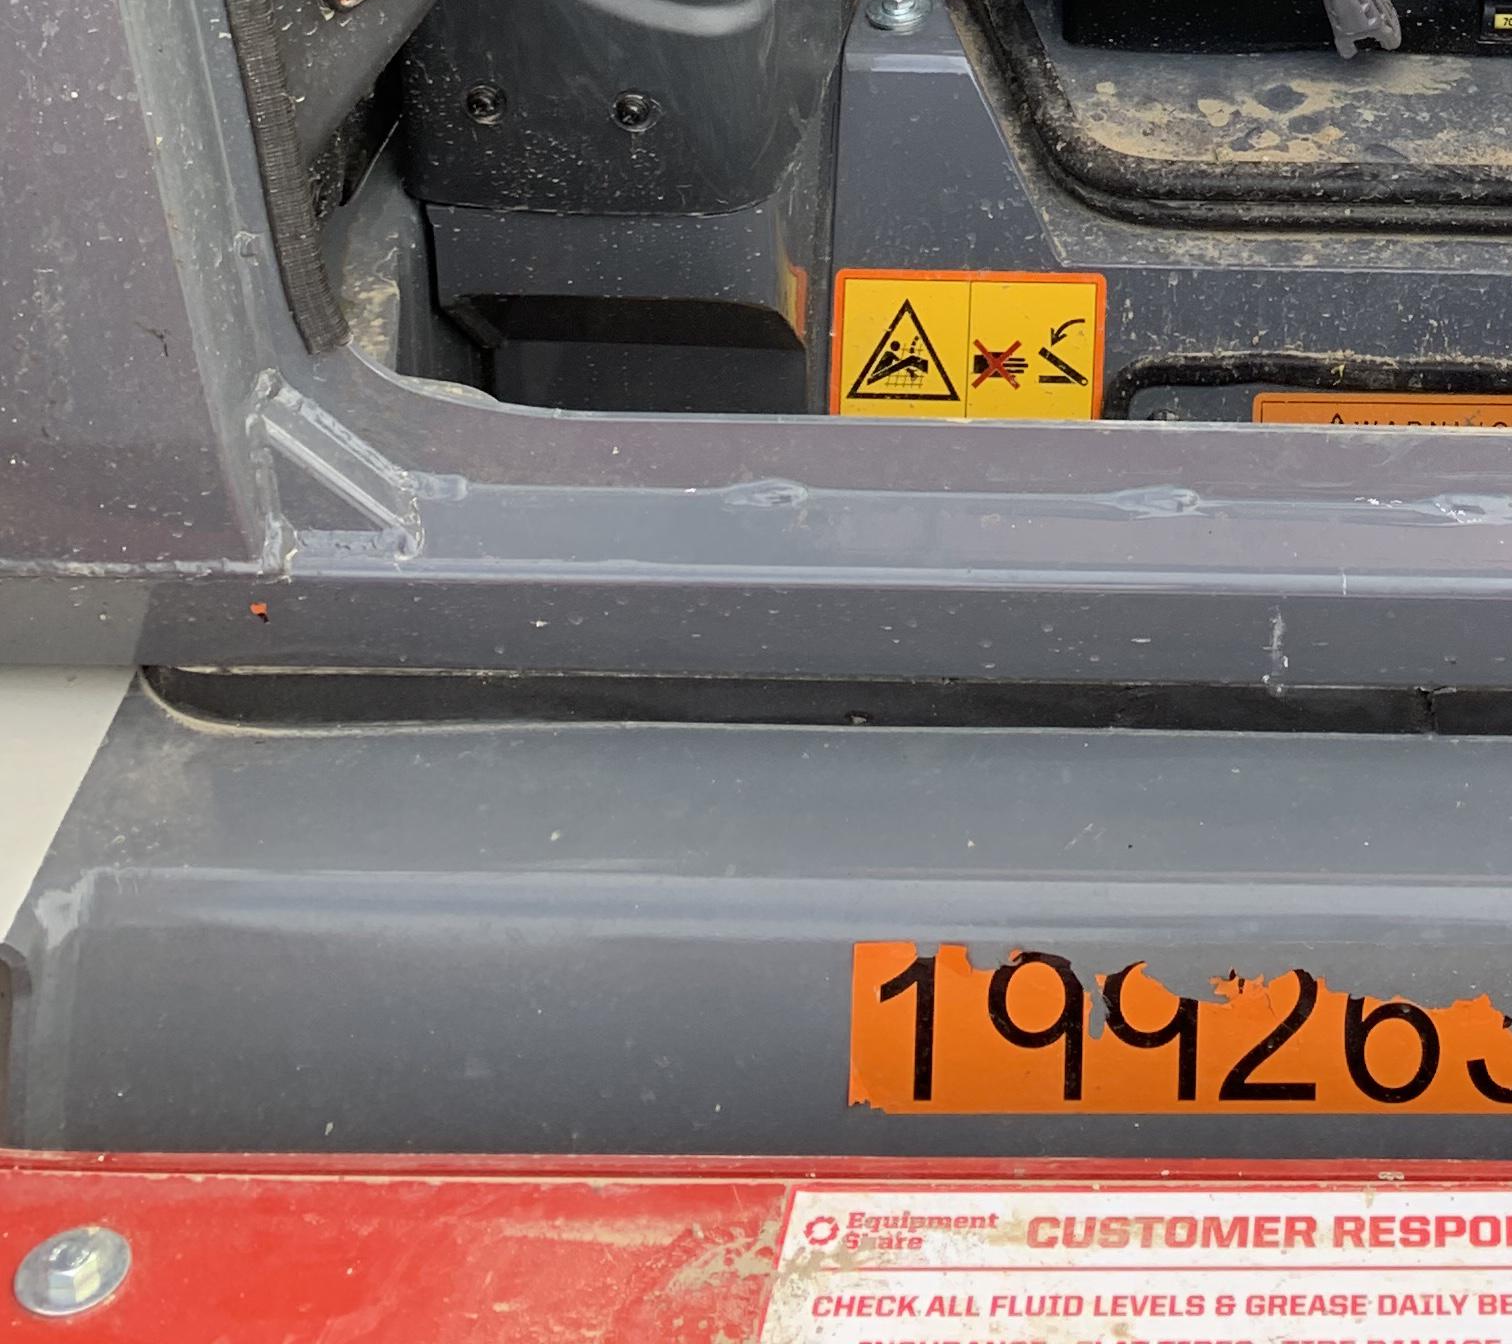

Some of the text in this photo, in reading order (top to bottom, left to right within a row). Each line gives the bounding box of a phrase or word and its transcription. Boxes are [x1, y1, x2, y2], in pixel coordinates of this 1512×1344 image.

[845, 1212, 999, 1234] Equipment
[1026, 1214, 1317, 1250] CUSTOMER
[845, 1231, 923, 1250] Sare
[811, 1295, 919, 1318] CHECK
[925, 1295, 981, 1317] ALL
[989, 1295, 1083, 1317] FLUID
[1094, 1294, 1205, 1317] LEVELS
[1214, 1294, 1235, 1317] &
[1245, 1293, 1372, 1317] GREASE
[1378, 1293, 1469, 1316] DAILY
